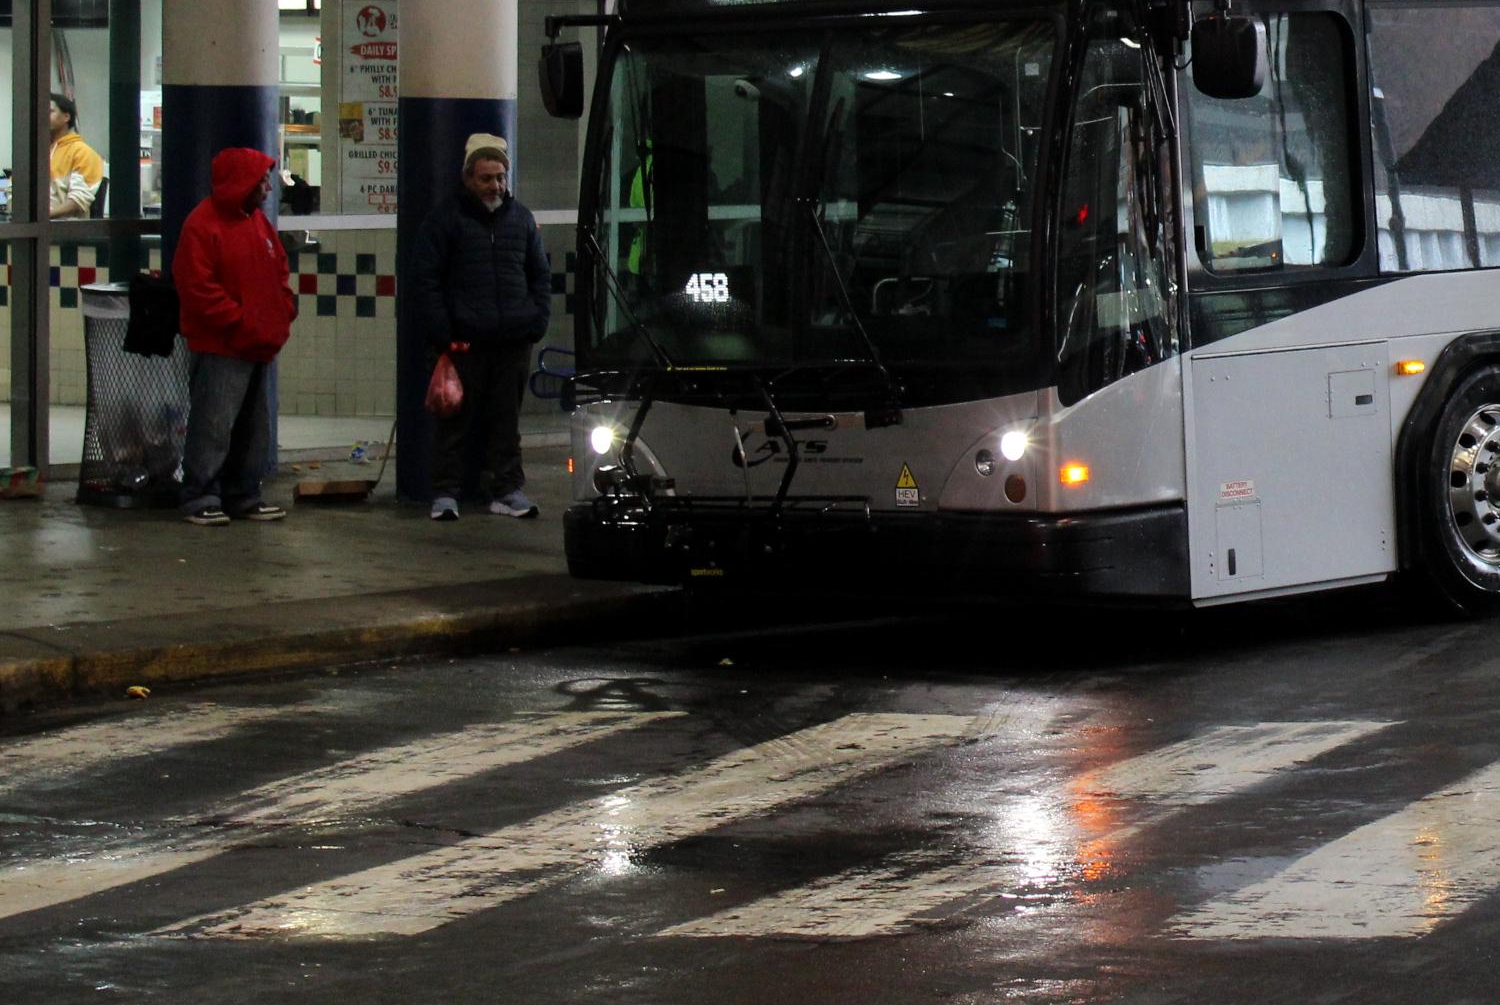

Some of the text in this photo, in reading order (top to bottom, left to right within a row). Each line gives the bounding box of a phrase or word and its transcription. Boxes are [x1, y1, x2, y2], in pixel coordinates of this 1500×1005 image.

[360, 45, 385, 56] DAILY
[360, 65, 383, 74] PHILLY
[386, 65, 397, 74] CH
[371, 75, 391, 85] WITH
[371, 117, 391, 126] WITH
[348, 150, 378, 159] GRILLED
[367, 184, 377, 194] PC
[685, 272, 729, 303] 458
[1225, 481, 1248, 490] BATTERY
[898, 489, 916, 499] HEV
[1221, 488, 1253, 497] DISCONNECT
